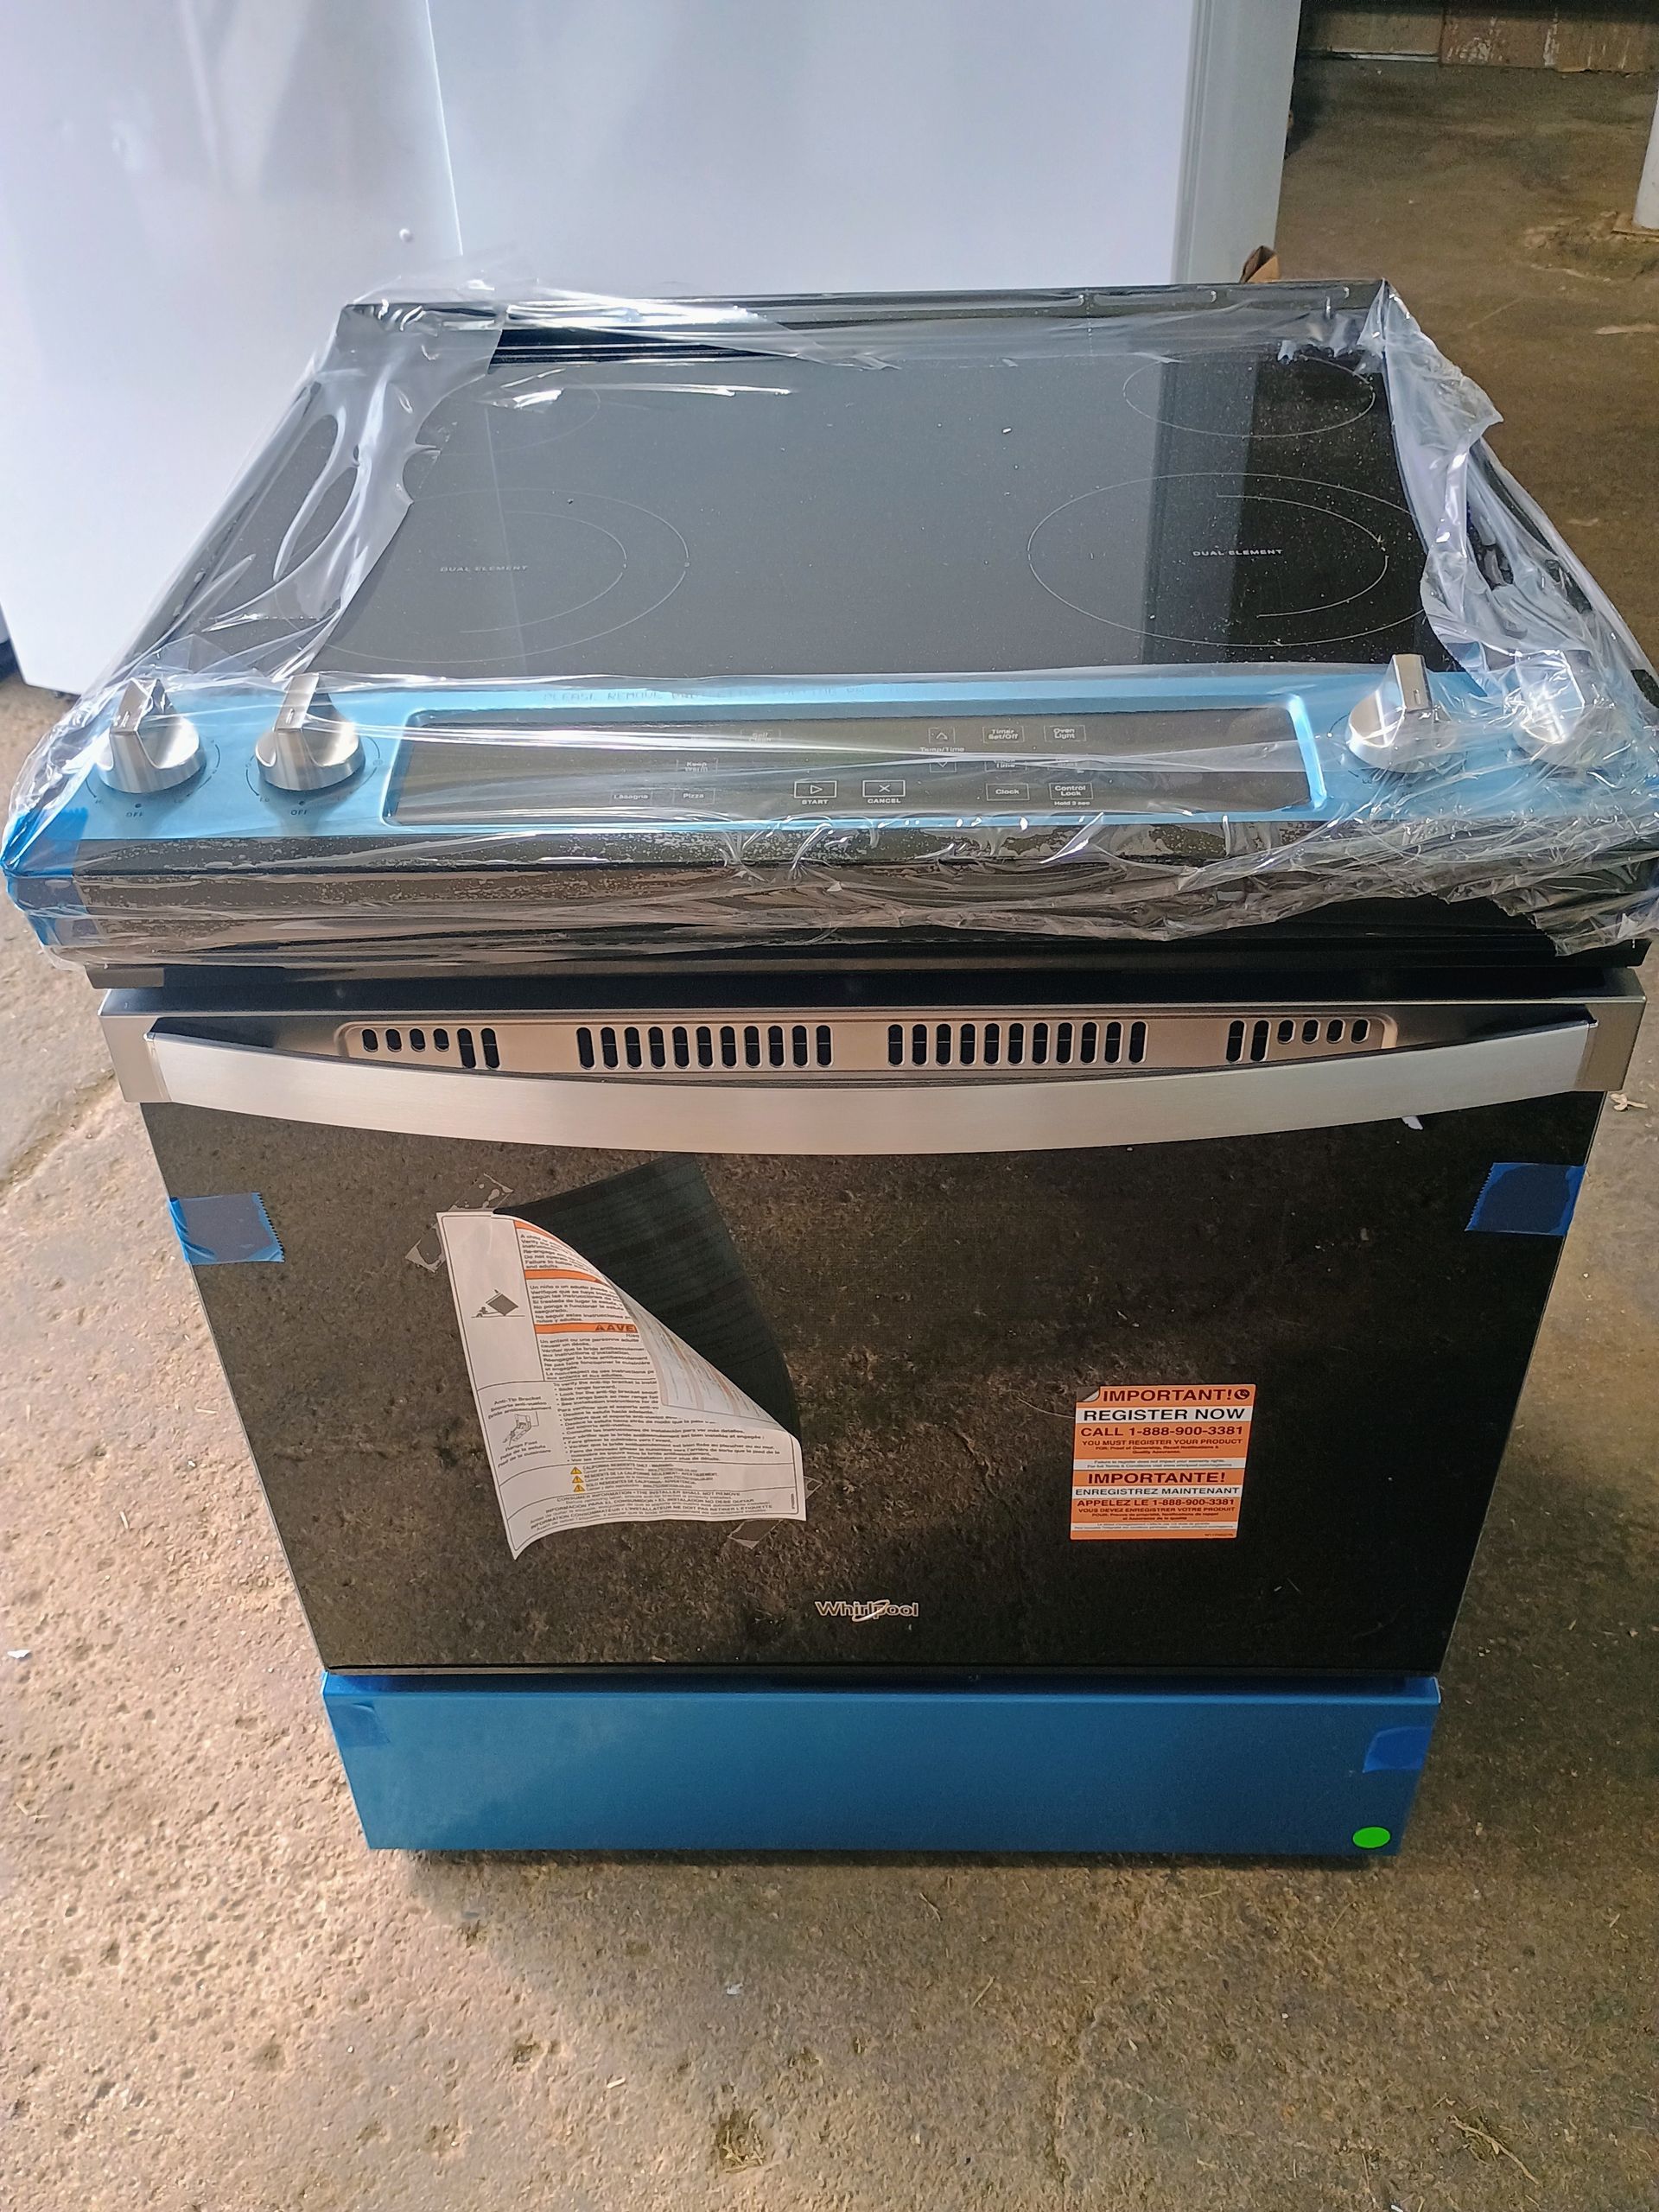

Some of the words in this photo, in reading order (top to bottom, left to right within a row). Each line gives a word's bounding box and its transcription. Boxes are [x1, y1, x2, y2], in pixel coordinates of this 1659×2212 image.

[1103, 1389, 1231, 1402] IMPORTANT!
[1084, 1409, 1188, 1421] REGISTER
[1195, 1408, 1245, 1420] NOW
[1080, 1427, 1123, 1437] CALL
[1129, 1427, 1243, 1436] 1-888-900-3381
[1088, 1472, 1225, 1484] IMPORTANTE!
[814, 1599, 919, 1622] Whirlpool
